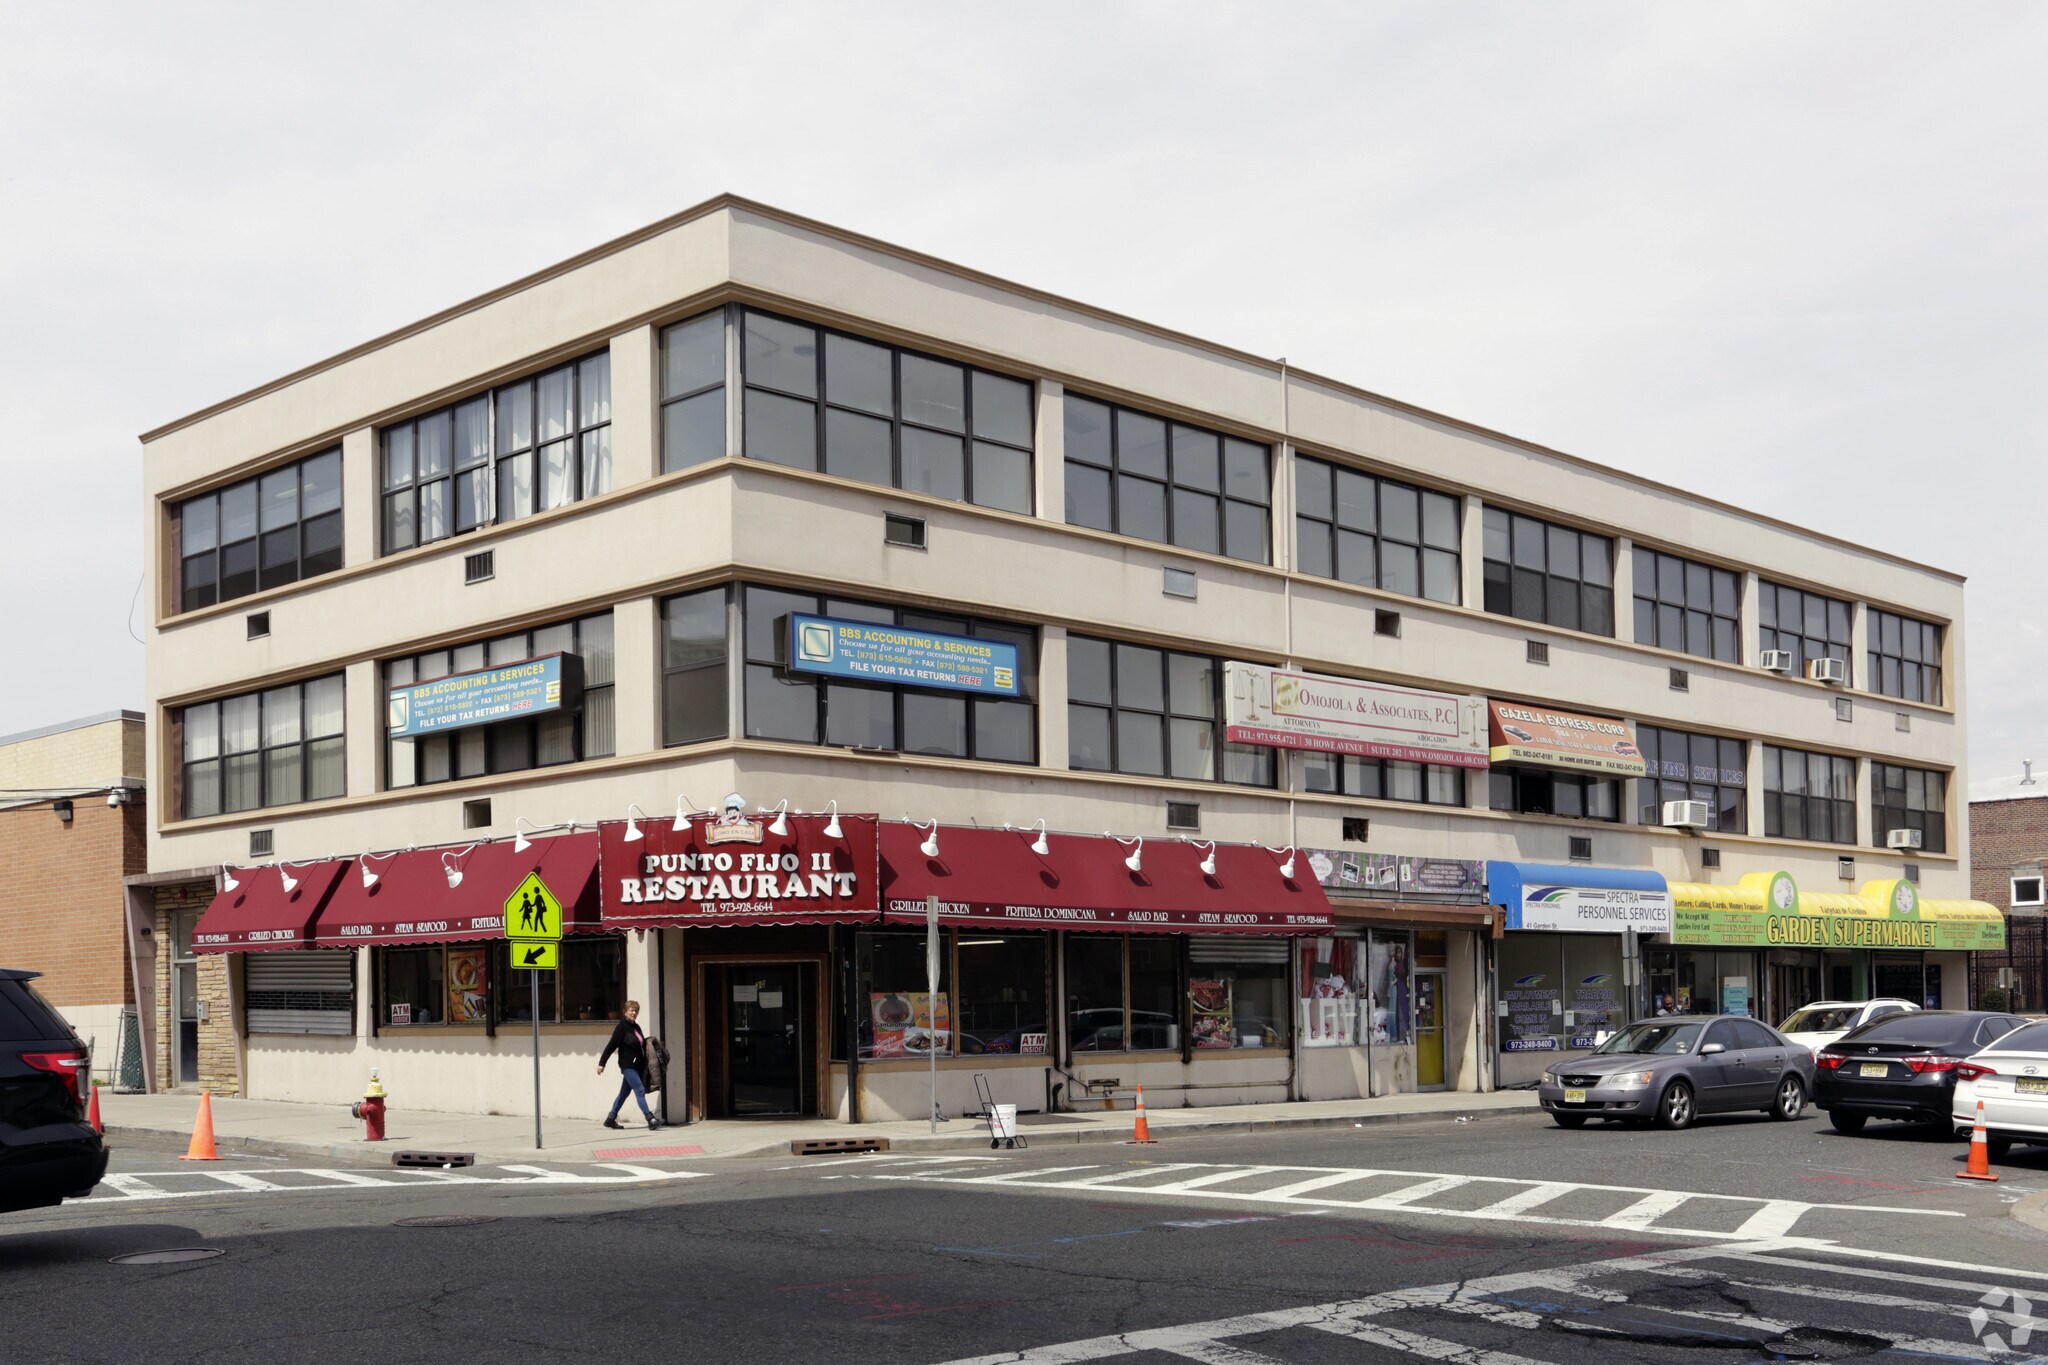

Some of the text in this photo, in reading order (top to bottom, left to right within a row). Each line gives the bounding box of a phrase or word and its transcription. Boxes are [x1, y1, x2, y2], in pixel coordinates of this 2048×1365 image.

[839, 627, 992, 657] BBS ACCOUNTING & SERVICES
[839, 638, 866, 648] Choose
[880, 643, 893, 652] for
[894, 644, 906, 653] all
[907, 648, 925, 658] your
[926, 650, 965, 663] accounting
[856, 650, 877, 661] (973)
[922, 659, 935, 668] FAX
[937, 660, 955, 671] (973)
[414, 663, 545, 699] BBS ACCOUNTING & SERVICES
[850, 661, 869, 672] FILE
[871, 663, 896, 675] YOUR
[899, 666, 915, 677] TAX
[917, 669, 956, 683] RETURNS
[958, 674, 982, 686] HERE
[414, 698, 434, 708] Choose
[445, 694, 455, 704] for
[457, 692, 467, 701] all
[468, 689, 483, 700] your
[484, 683, 519, 697] accounting
[427, 704, 443, 716] (973)
[481, 696, 492, 705] FAX
[493, 691, 511, 703] (973)
[420, 698, 533, 728] FILE YOUR TAX RETURNS HERE
[1356, 697, 1367, 713] &
[1435, 707, 1456, 725] P.C.
[1283, 718, 1321, 729] ATTORNEYS
[1499, 706, 1546, 724] GAZELA
[1547, 714, 1596, 732] EXPRESS
[1597, 722, 1625, 736] CORP
[1417, 734, 1448, 743] ABOGADOS
[1238, 730, 1255, 740] TEL:
[1257, 733, 1296, 744] 973.955.4721
[1305, 738, 1312, 746] 30
[1313, 739, 1336, 749] HOWE
[1337, 741, 1363, 753] AVENUE
[1371, 745, 1391, 756] SUITE
[1408, 750, 1488, 766] WWW.OMOJOLALAW.COM
[1512, 749, 1522, 757] TEL
[1606, 761, 1616, 769] FAX
[645, 852, 832, 873] PUNTO FIJO II
[620, 872, 857, 903] RESTAURANT
[1607, 891, 1639, 904] SPECTRA
[700, 902, 773, 913] TEL 973-928-6644
[889, 900, 928, 912] GRILLED
[938, 902, 970, 914] HICKEN
[1005, 905, 1042, 918] FRITURA
[1044, 907, 1097, 920] DOMINICANA
[1127, 911, 1151, 921] SALAD
[1153, 912, 1169, 922] BAR
[1198, 913, 1220, 923] STEAM
[1223, 913, 1258, 924] SEAFOOD
[1578, 905, 1667, 921] PERSONNEL SERVICES
[1685, 913, 1700, 921] Accept
[248, 931, 271, 941] GRILLED
[271, 929, 294, 940] CHICKEN
[340, 925, 359, 935] SALAD
[360, 925, 373, 935] BAR
[395, 923, 414, 934] STEAM
[416, 921, 447, 932] SEAFOOD
[471, 916, 500, 929] FRITURA
[1766, 914, 1937, 947] GARDEN SUPERMARKET
[1982, 931, 2002, 939] Delivery
[1986, 923, 1998, 931] Free
[1504, 990, 1557, 1000] EMPLOYMENT
[1576, 990, 1614, 999] TRABAJO
[392, 1005, 409, 1015] ATM
[1509, 1001, 1552, 1011] AVAILABLE
[1571, 1001, 1619, 1011] DISPONIBLE
[1515, 1014, 1548, 1023] COME IN
[1512, 1024, 1550, 1034] TO APPLY
[1022, 1035, 1046, 1045] ATM
[1511, 1040, 1552, 1049] 973-249-9400
